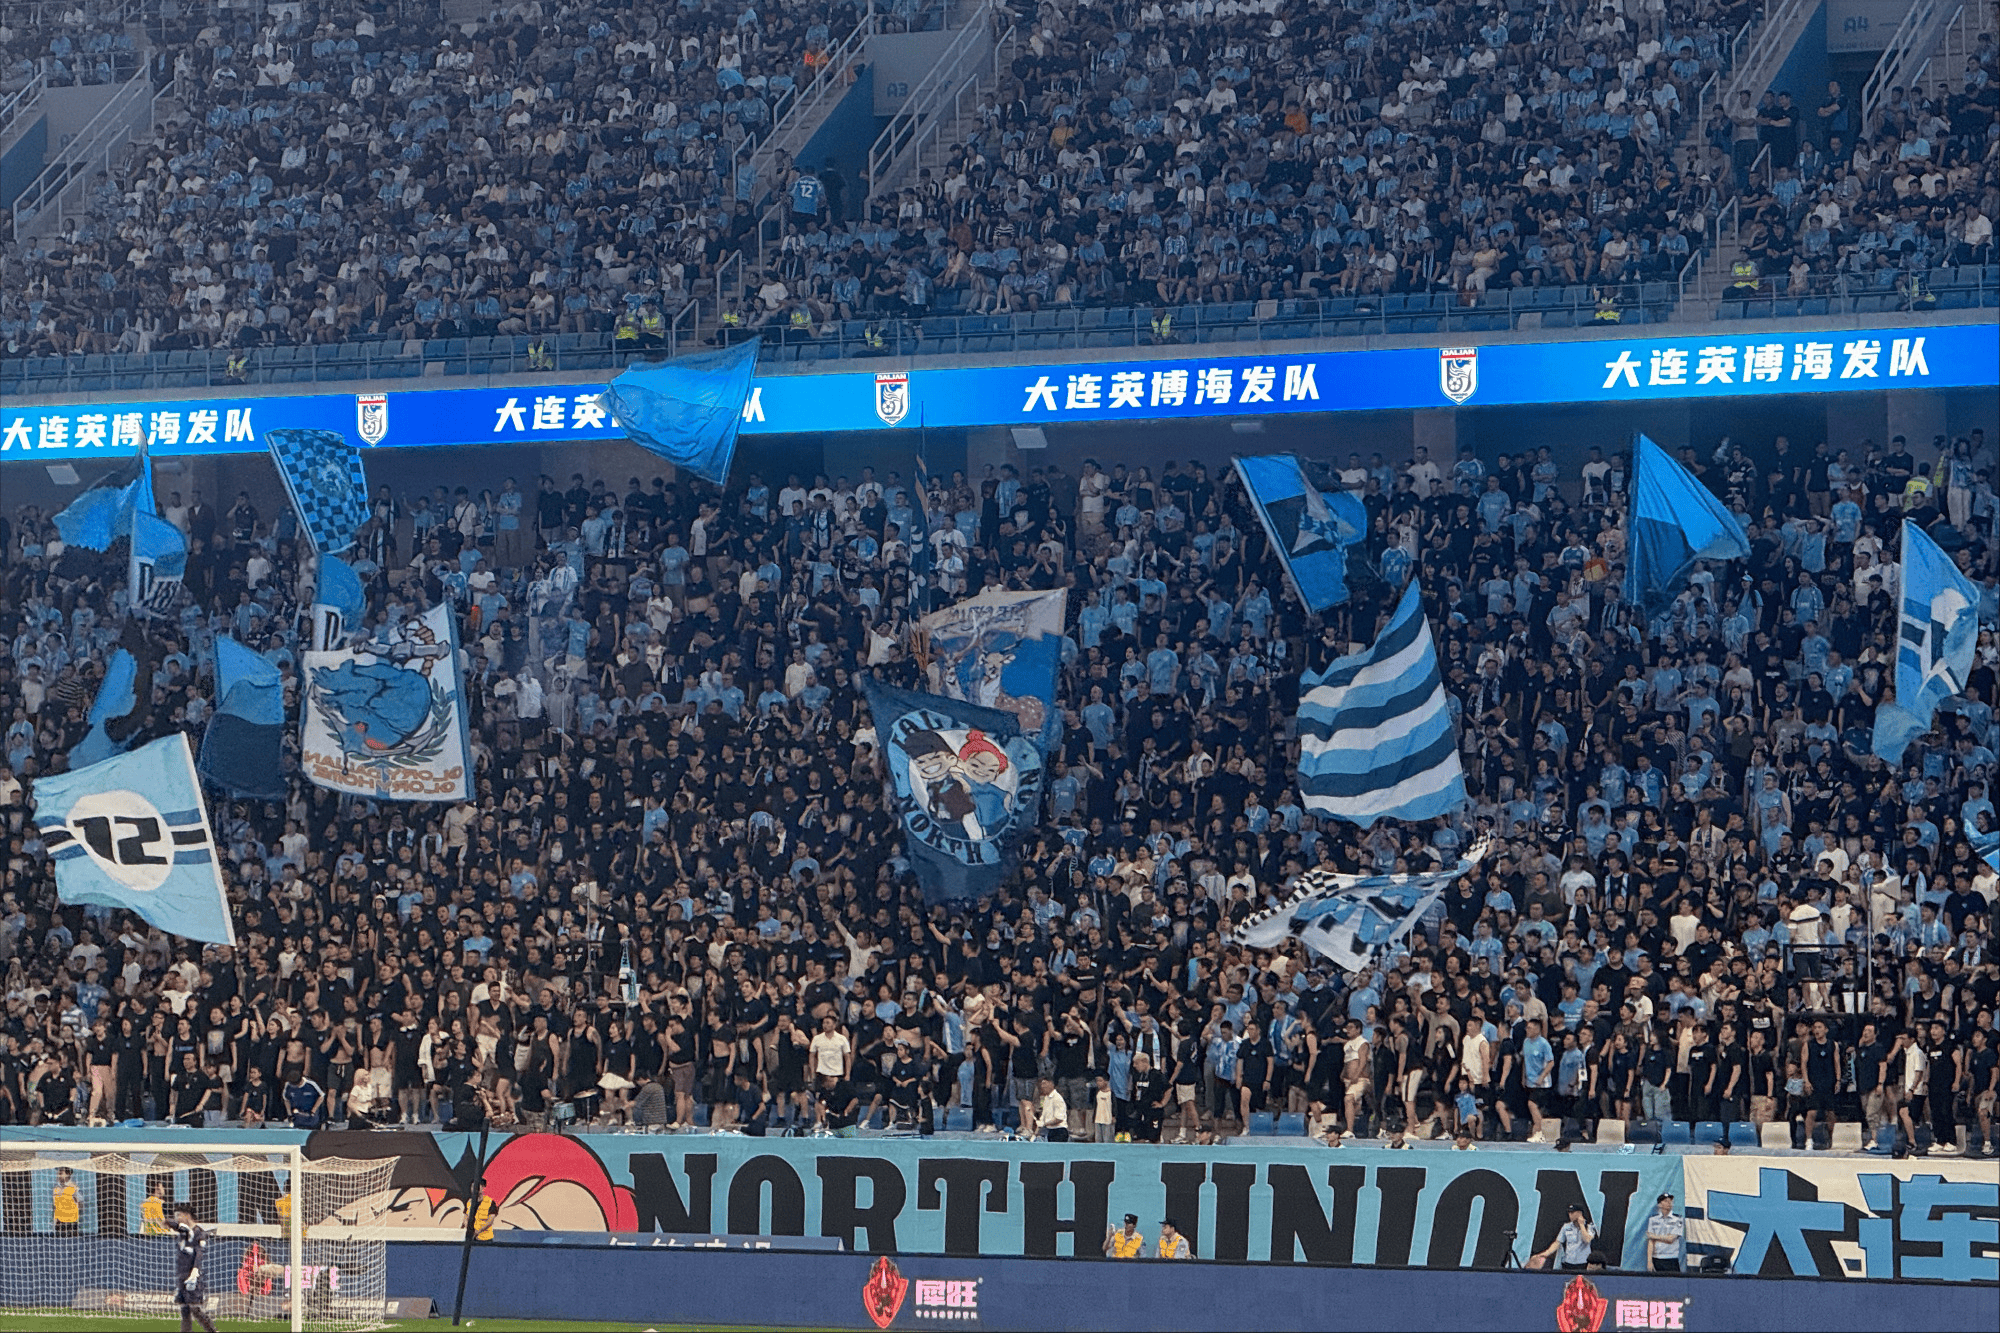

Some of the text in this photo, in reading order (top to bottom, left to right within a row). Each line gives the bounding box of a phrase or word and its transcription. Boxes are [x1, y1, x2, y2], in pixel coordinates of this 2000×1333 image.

[801, 185, 813, 197] 12
[1022, 363, 1320, 411] 大连英博海发队
[1602, 337, 1930, 388] 大连英博海发队
[2, 408, 255, 451] 大连英博海发队
[72, 815, 169, 865] 12
[629, 1152, 1641, 1270] NORTH UNION
[1706, 1166, 2000, 1282] 大连
